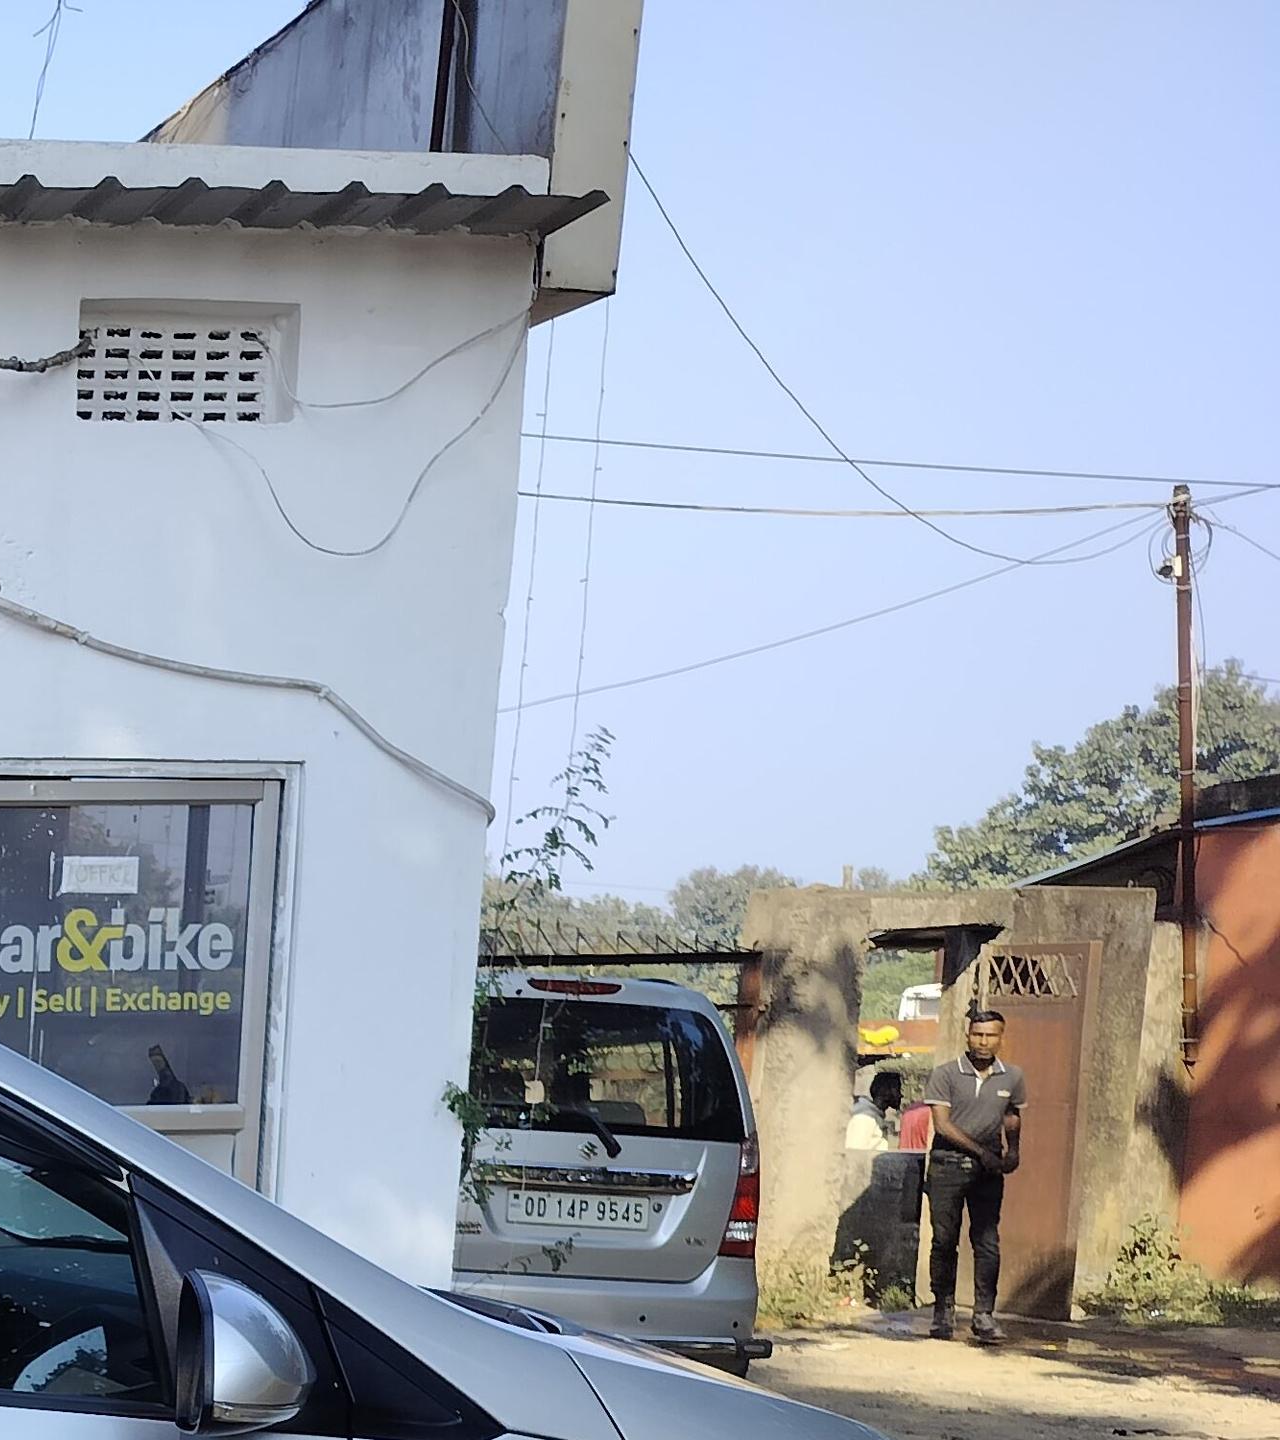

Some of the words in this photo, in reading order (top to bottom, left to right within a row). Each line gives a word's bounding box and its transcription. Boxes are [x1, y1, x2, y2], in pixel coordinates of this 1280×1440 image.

[33, 986, 82, 1014] Sell
[105, 985, 231, 1016] Exchange
[596, 1201, 643, 1224] 9545
